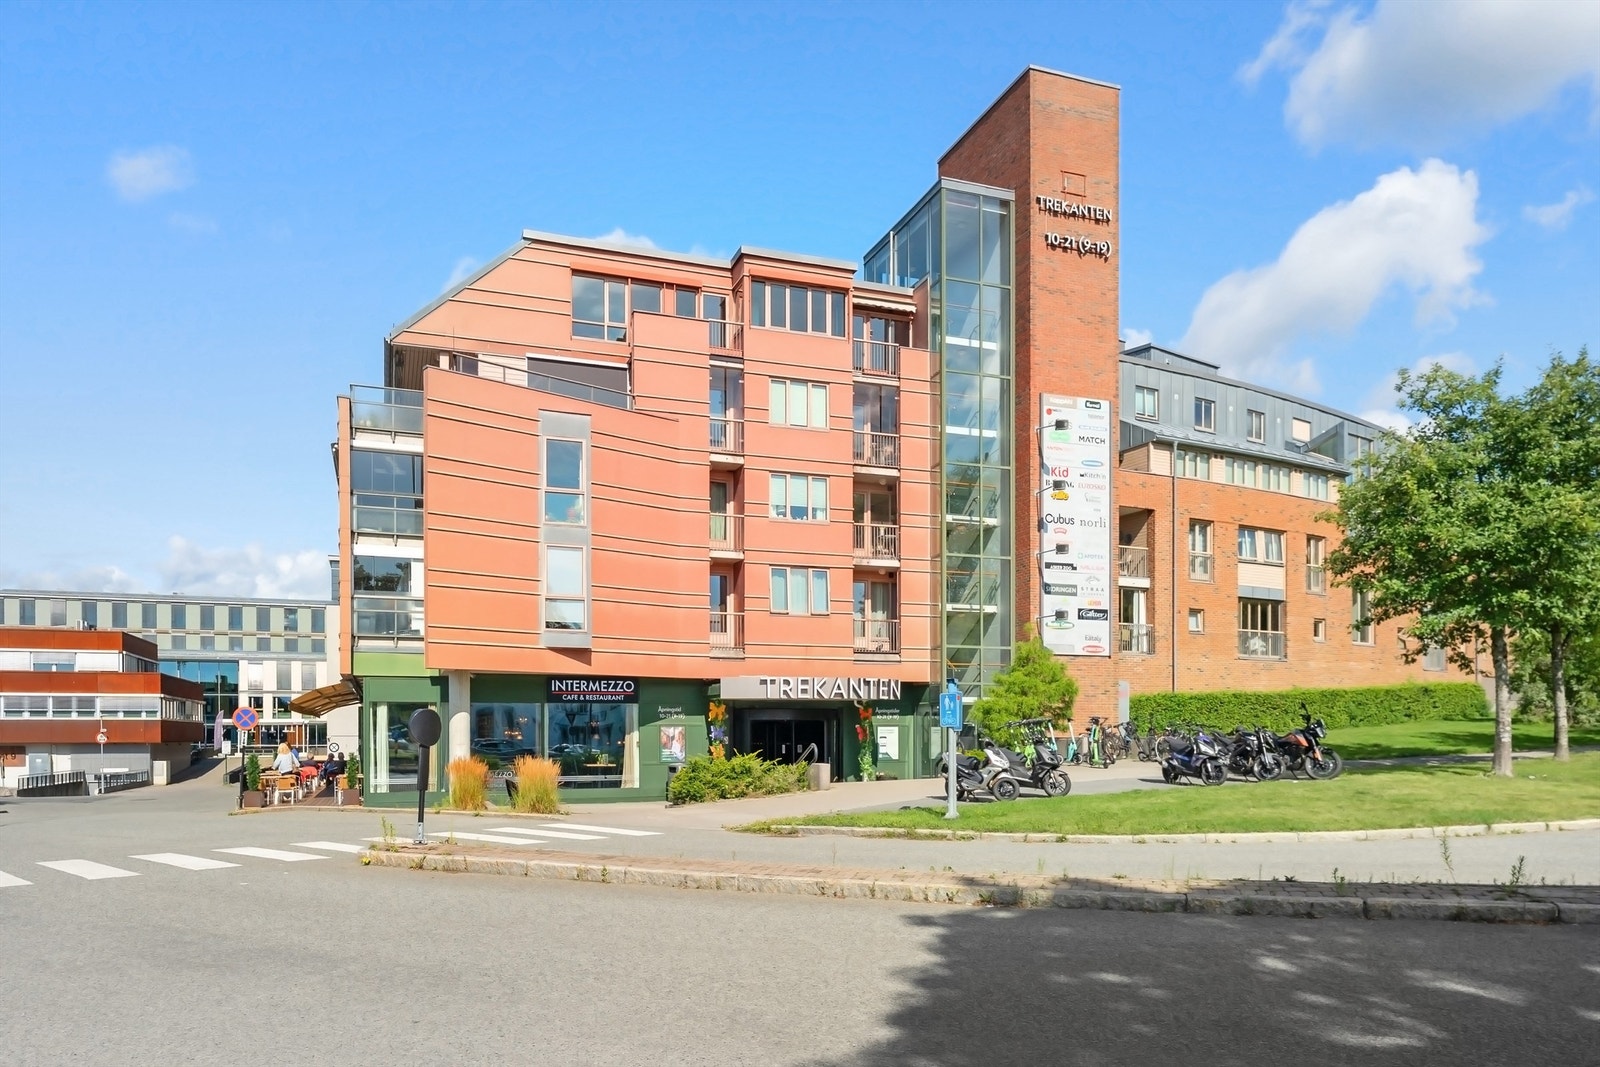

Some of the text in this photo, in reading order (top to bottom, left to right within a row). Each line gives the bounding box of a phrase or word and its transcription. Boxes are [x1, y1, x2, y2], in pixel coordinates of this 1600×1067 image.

[1037, 195, 1112, 221] TREKANTEN
[1046, 232, 1112, 257] 10-21 (9-19)
[1078, 436, 1106, 445] MATCH
[1051, 467, 1069, 478] Kid
[1044, 513, 1075, 525] Cubus
[1080, 517, 1106, 528] norli
[551, 679, 635, 692] INTERMEZZO
[760, 676, 902, 701] TREKANTEN
